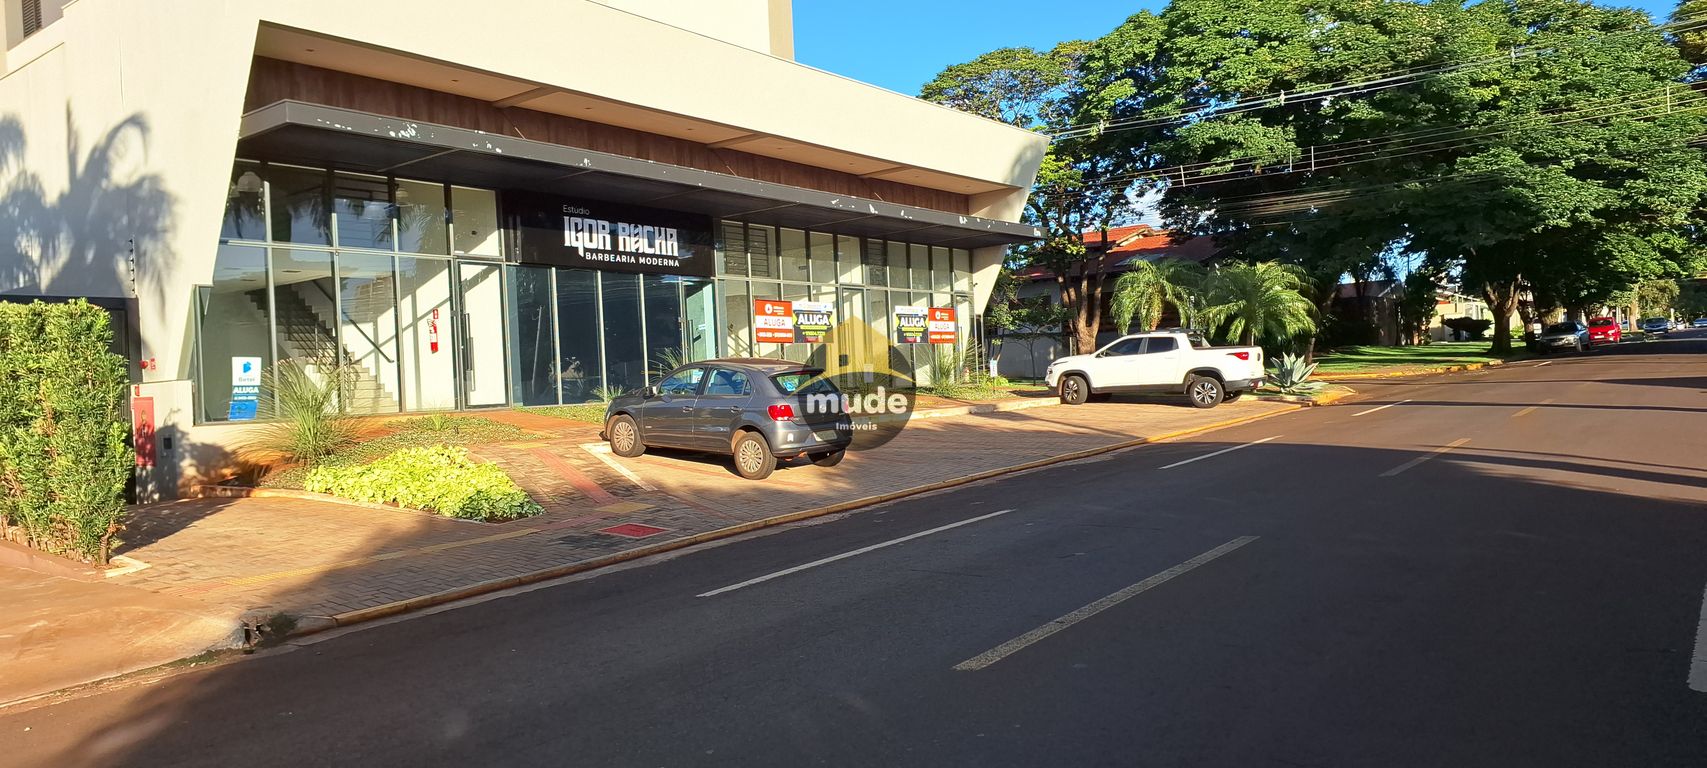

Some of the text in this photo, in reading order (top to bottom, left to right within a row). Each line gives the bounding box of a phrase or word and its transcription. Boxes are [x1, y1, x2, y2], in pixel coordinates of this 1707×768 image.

[564, 216, 611, 257] IGOR
[585, 252, 680, 267] BARBEARIA MODERNA
[763, 318, 786, 327] ALUGA
[797, 314, 830, 325] ALUGA
[900, 317, 926, 328] ALUGA
